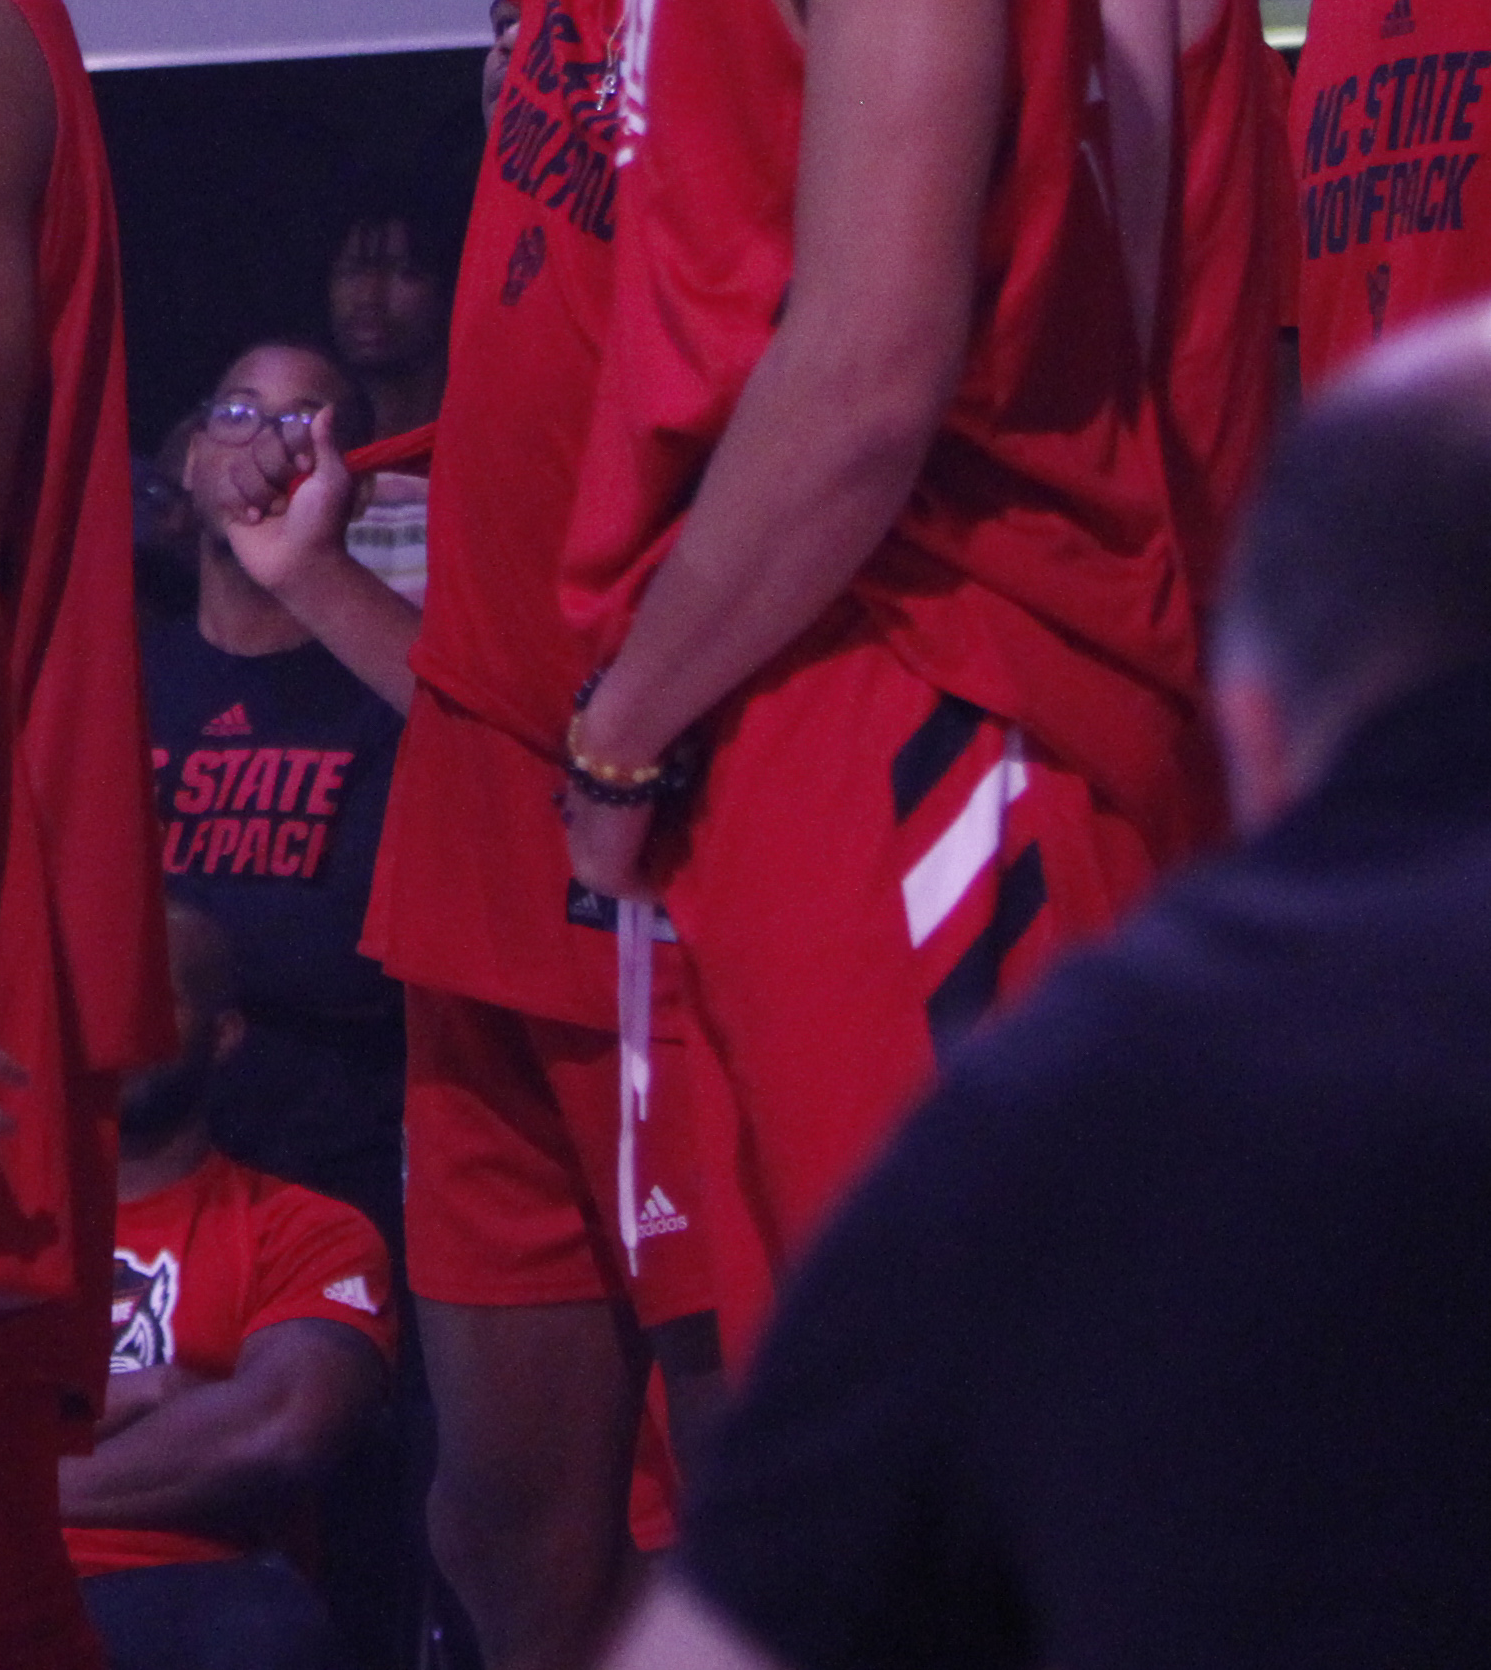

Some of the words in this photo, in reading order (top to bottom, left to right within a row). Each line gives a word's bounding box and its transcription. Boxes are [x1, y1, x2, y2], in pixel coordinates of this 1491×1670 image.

[1302, 74, 1359, 179] NC
[1359, 50, 1491, 157] STATE
[173, 747, 356, 815] STATE
